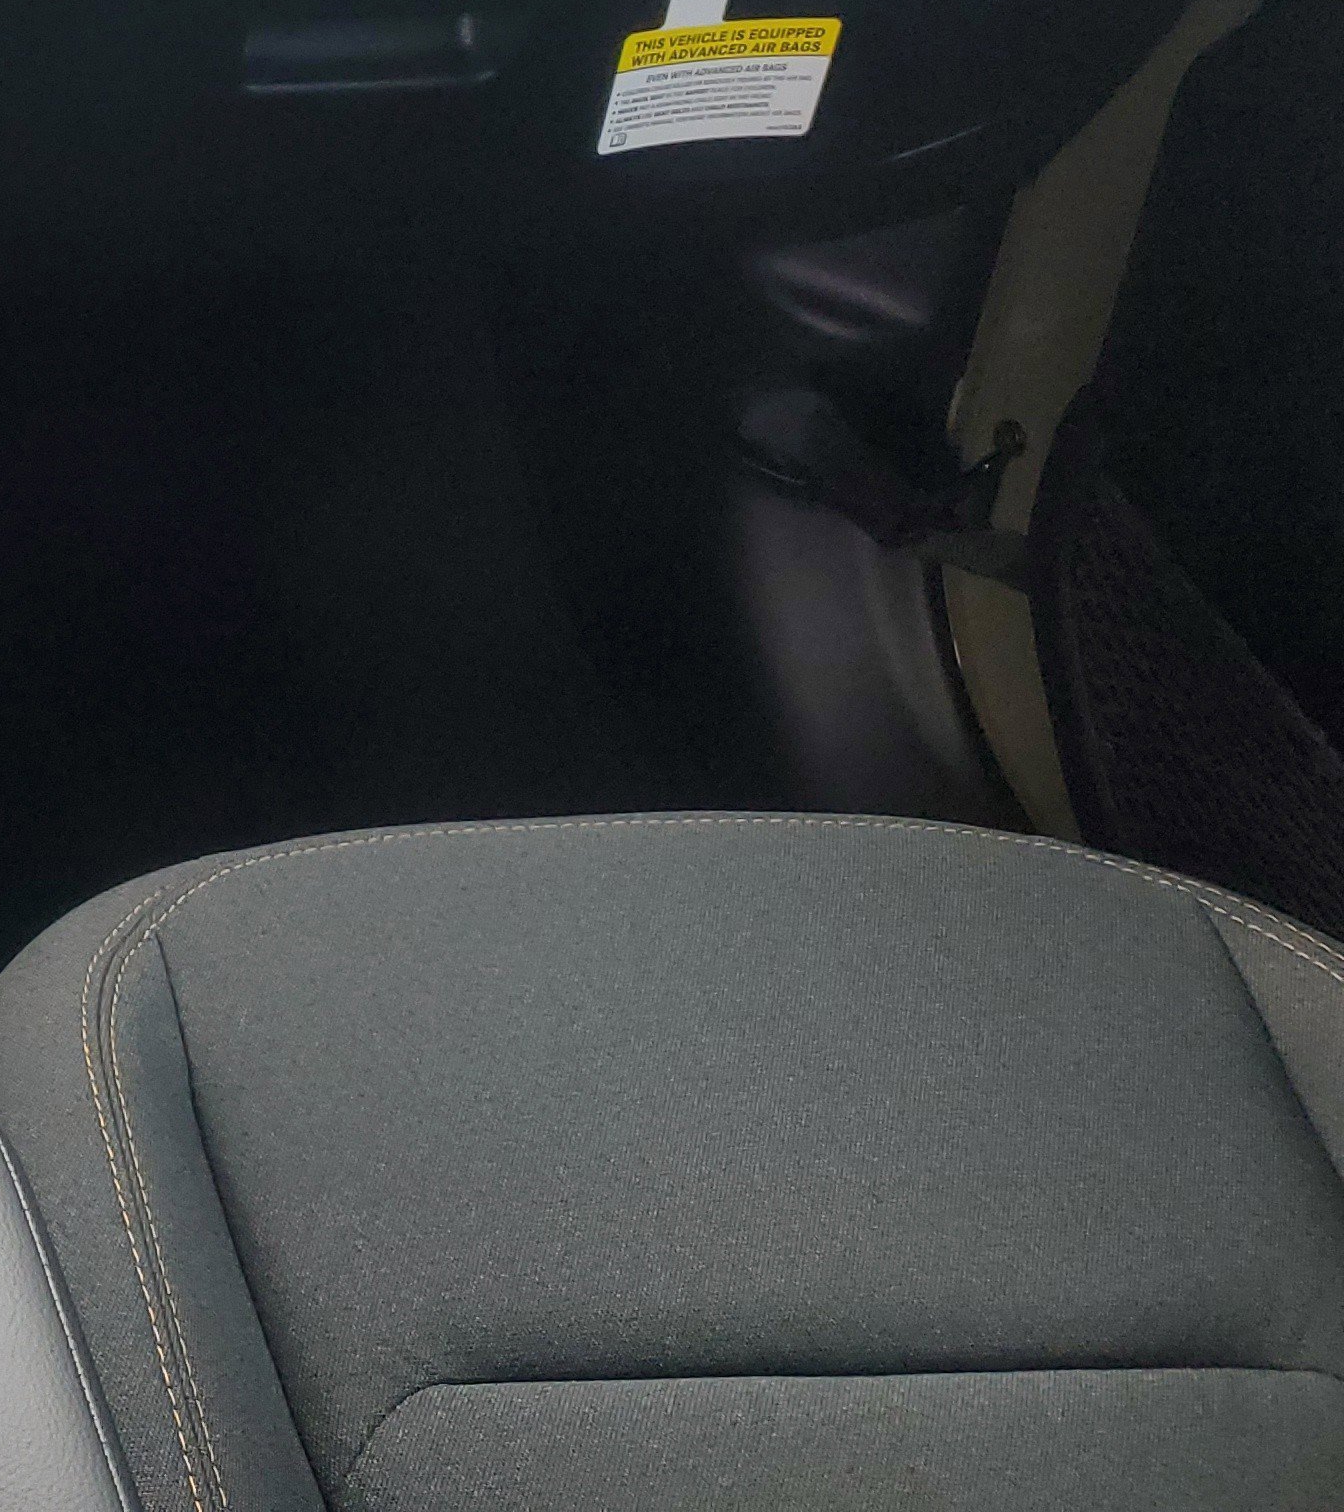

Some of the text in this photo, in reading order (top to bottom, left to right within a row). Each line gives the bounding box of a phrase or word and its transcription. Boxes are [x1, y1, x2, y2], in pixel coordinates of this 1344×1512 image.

[631, 40, 822, 67] WITH ADVANCED AIR BAGS
[635, 27, 826, 54] THIS VEHICLE IS EQUIPPED
[671, 69, 693, 79] WITH
[695, 65, 743, 76] ADVANCED
